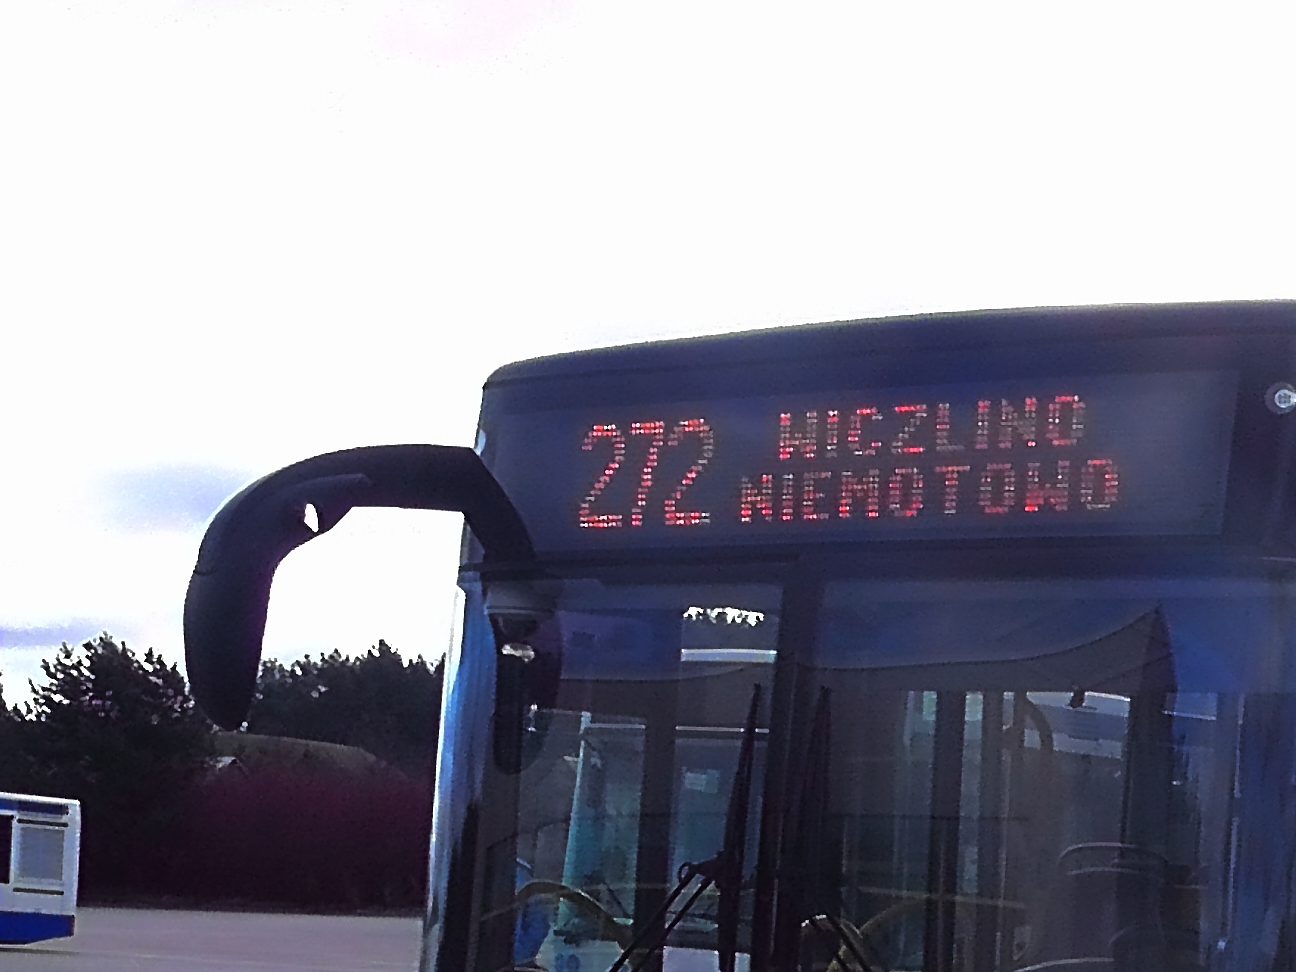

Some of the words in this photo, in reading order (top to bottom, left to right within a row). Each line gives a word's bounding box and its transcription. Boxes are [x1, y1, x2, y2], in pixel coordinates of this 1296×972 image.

[779, 395, 1087, 460] WICZLINO
[580, 418, 714, 528] 272
[740, 459, 1120, 523] NIEMOTOWO
